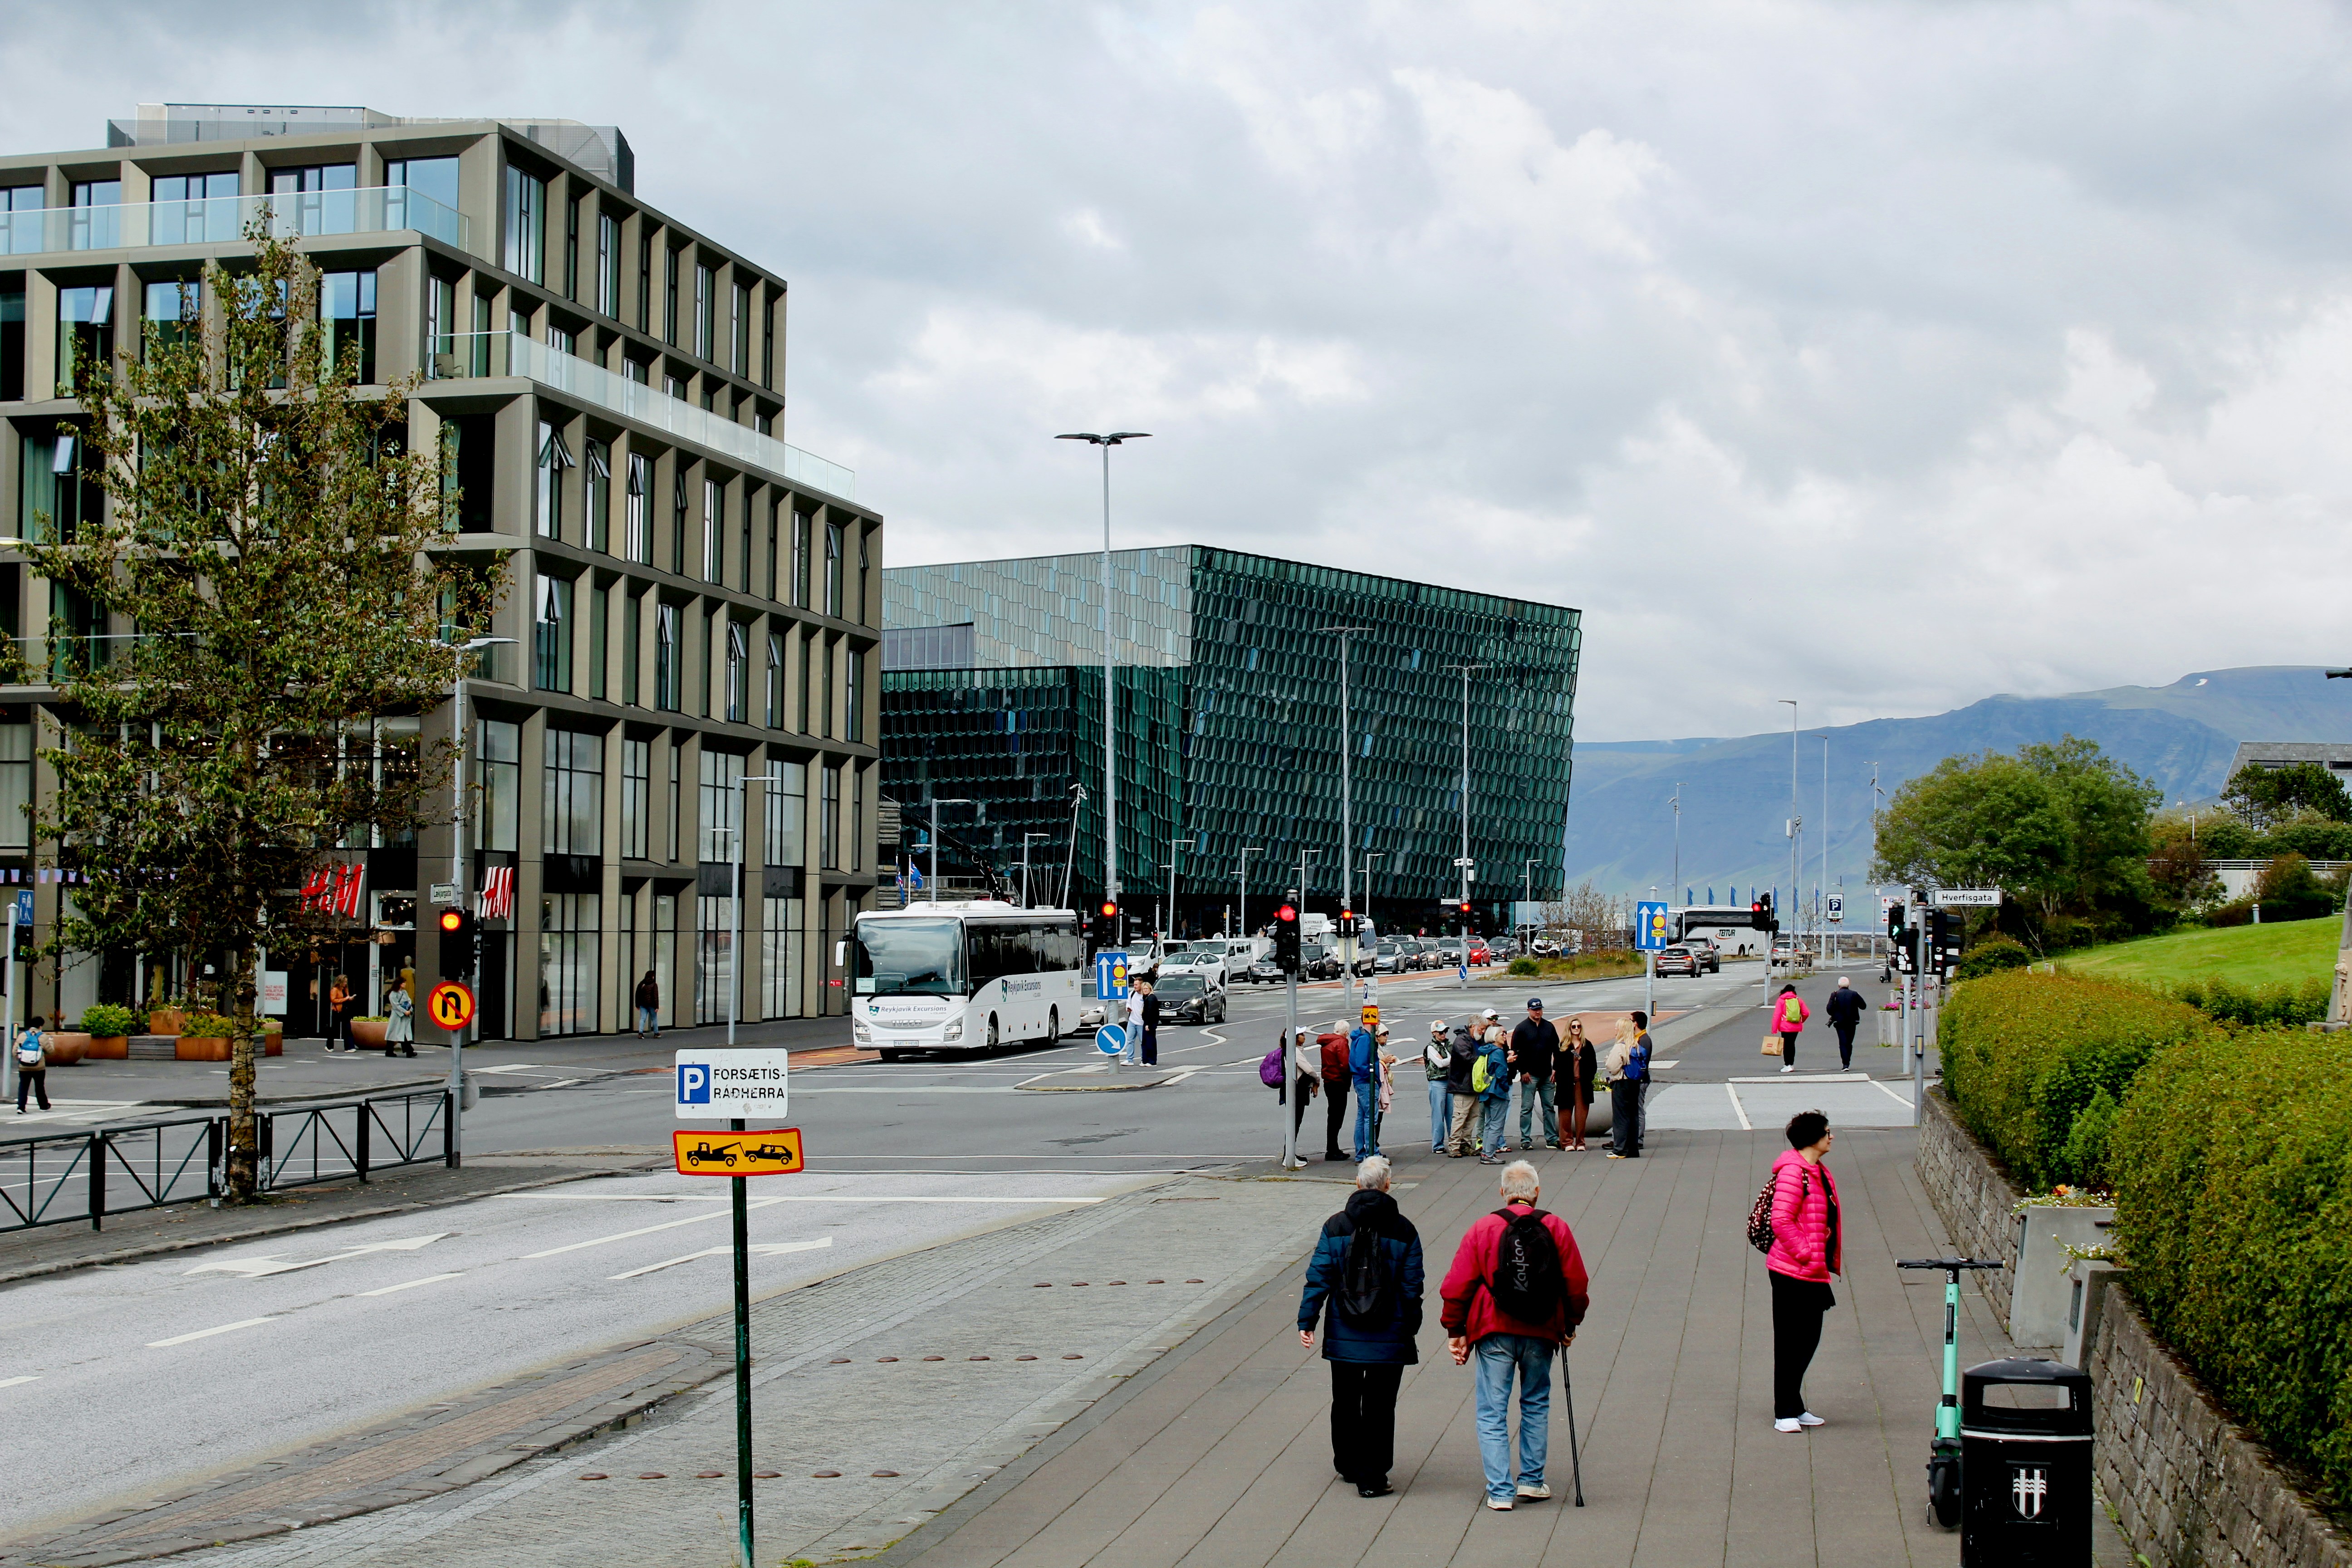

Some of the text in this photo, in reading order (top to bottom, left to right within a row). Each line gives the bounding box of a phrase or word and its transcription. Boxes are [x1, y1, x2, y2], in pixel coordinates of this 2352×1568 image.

[481, 866, 514, 920] H&M
[1942, 894, 1992, 902] Hverfisgata
[1832, 902, 1838, 910] P
[1008, 979, 1041, 995] Reykjavik Excursions
[881, 1005, 911, 1014] Reykjavik
[714, 1068, 785, 1080] FORSÆTIS-
[684, 1068, 705, 1101] P
[714, 1084, 785, 1098] RÁÐHERRA
[1512, 1239, 1529, 1292] Kayton
